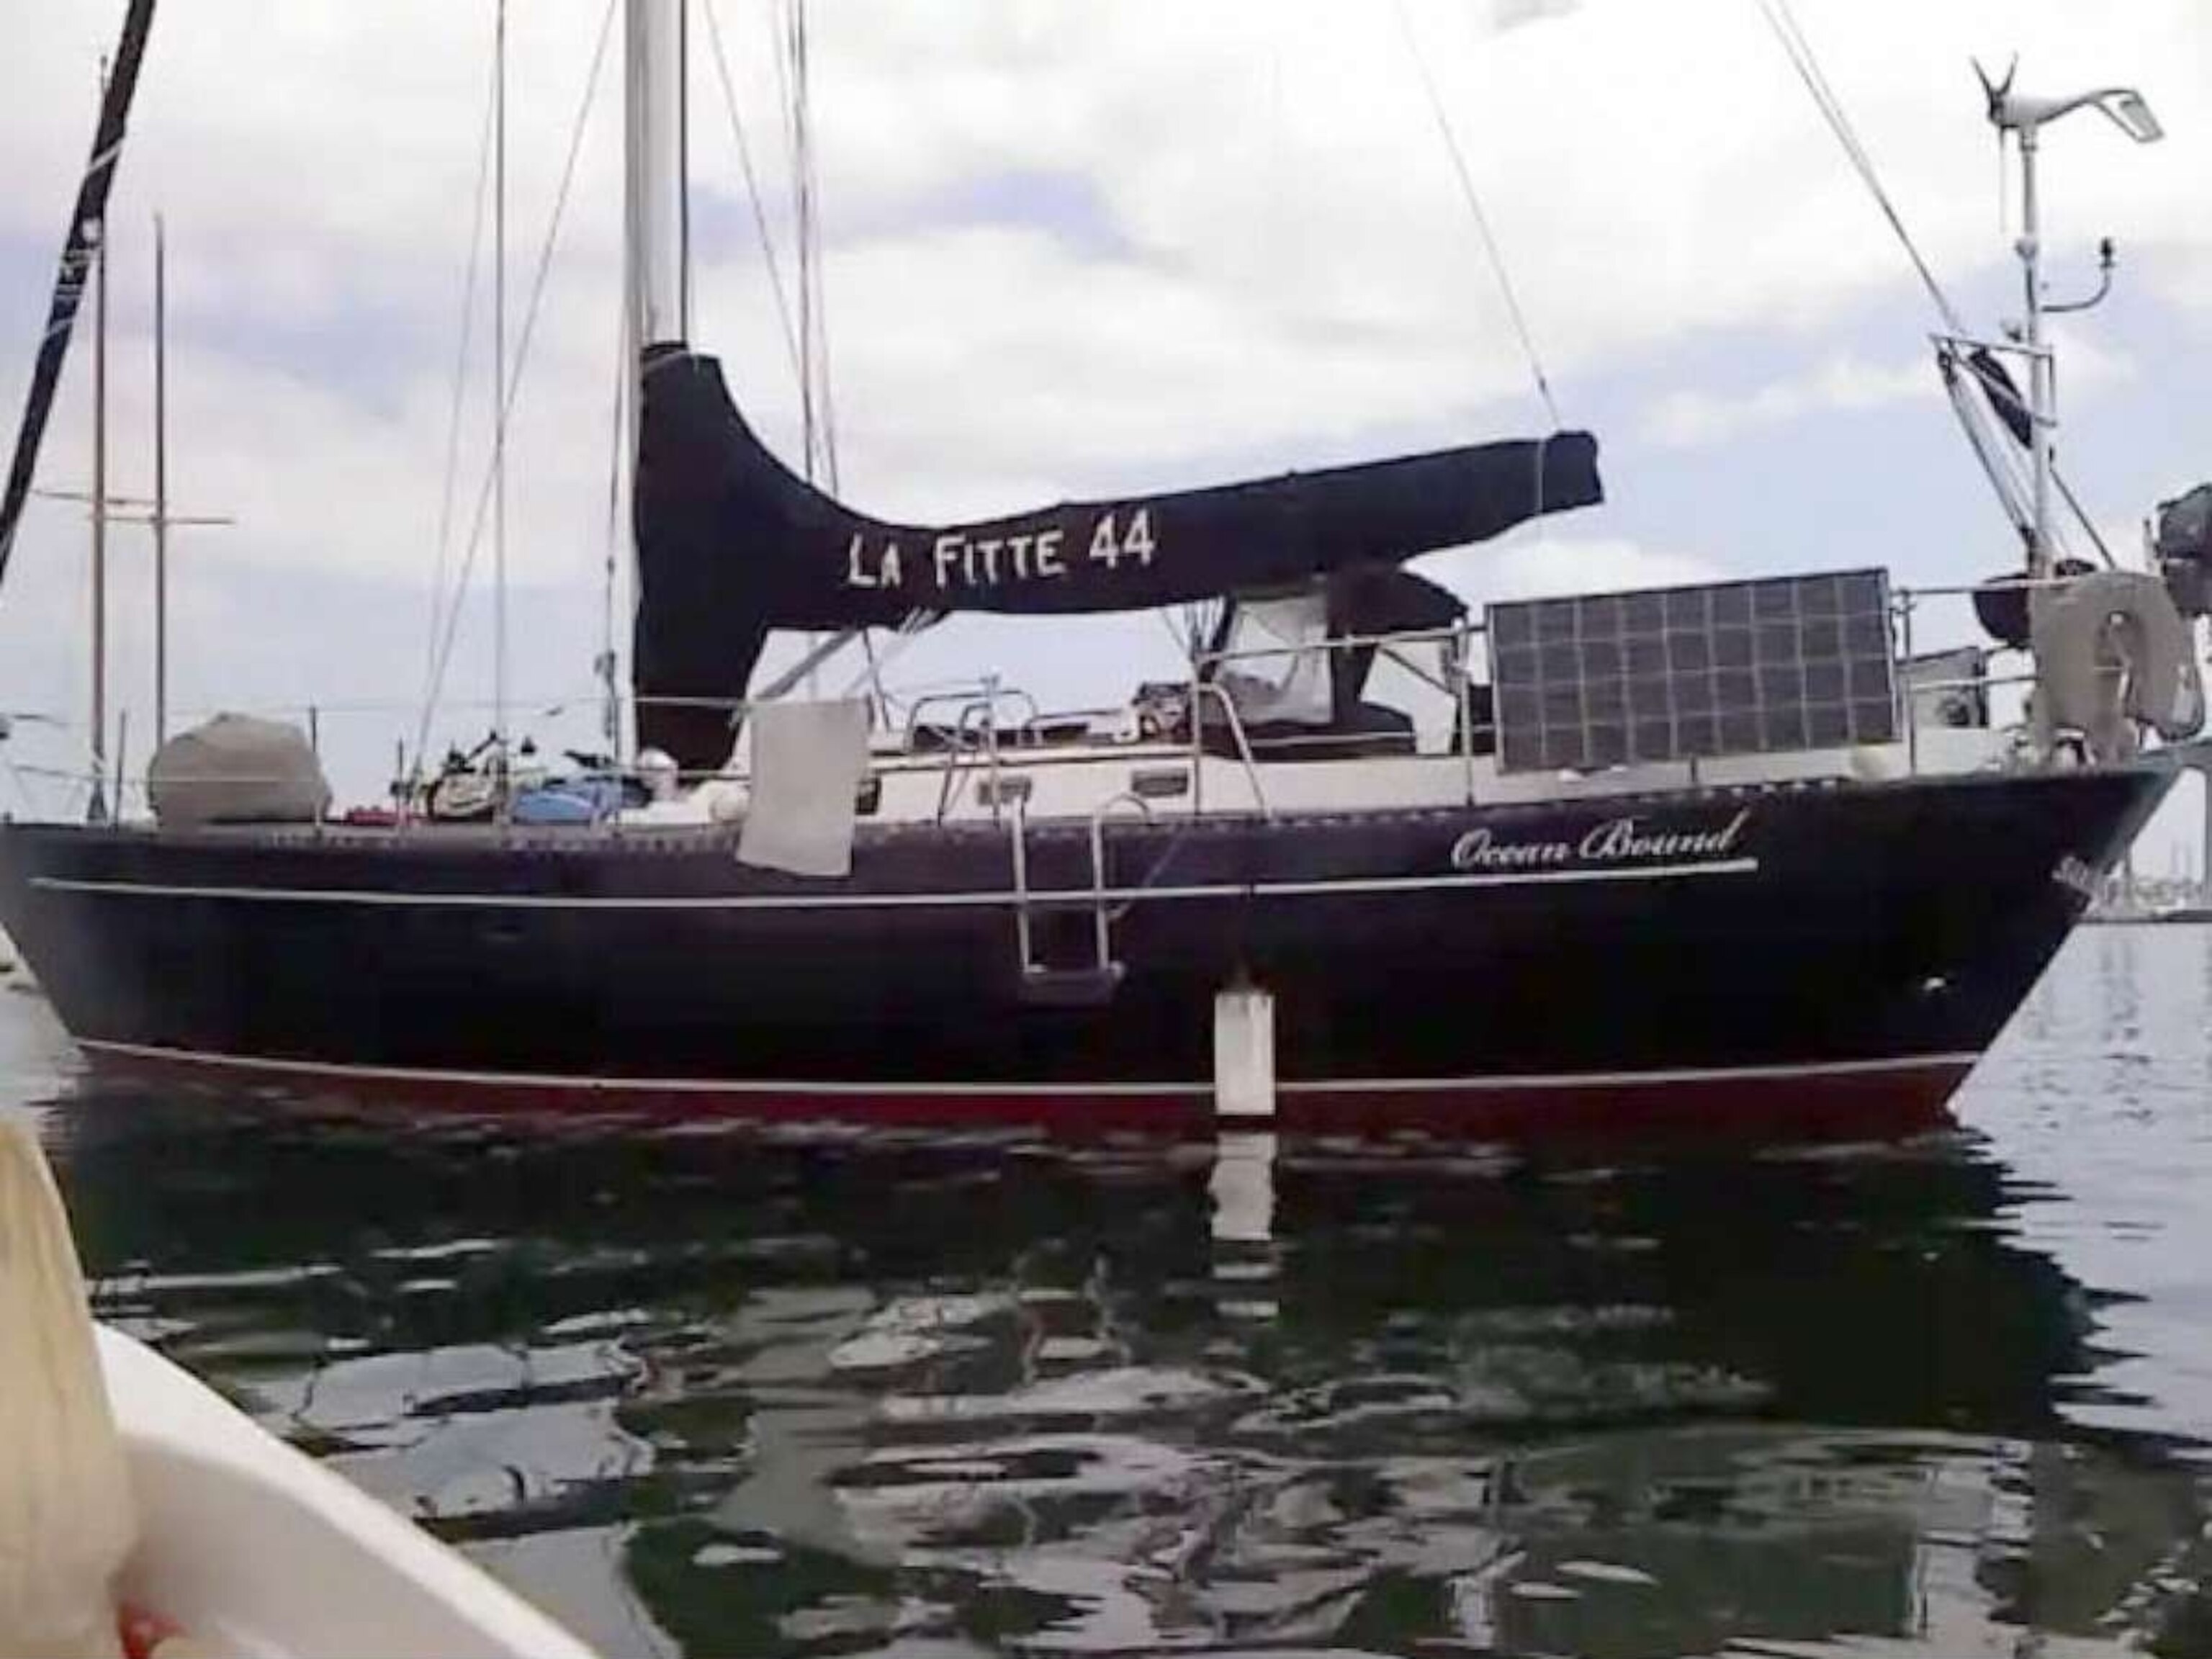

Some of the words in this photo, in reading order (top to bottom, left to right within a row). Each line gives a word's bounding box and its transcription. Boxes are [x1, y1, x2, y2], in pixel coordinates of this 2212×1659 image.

[848, 533, 901, 588] LA
[933, 531, 1066, 588] FITTE
[1089, 509, 1154, 568] 44
[1451, 828, 1570, 868] Ocean
[1579, 808, 1750, 859] Bound
